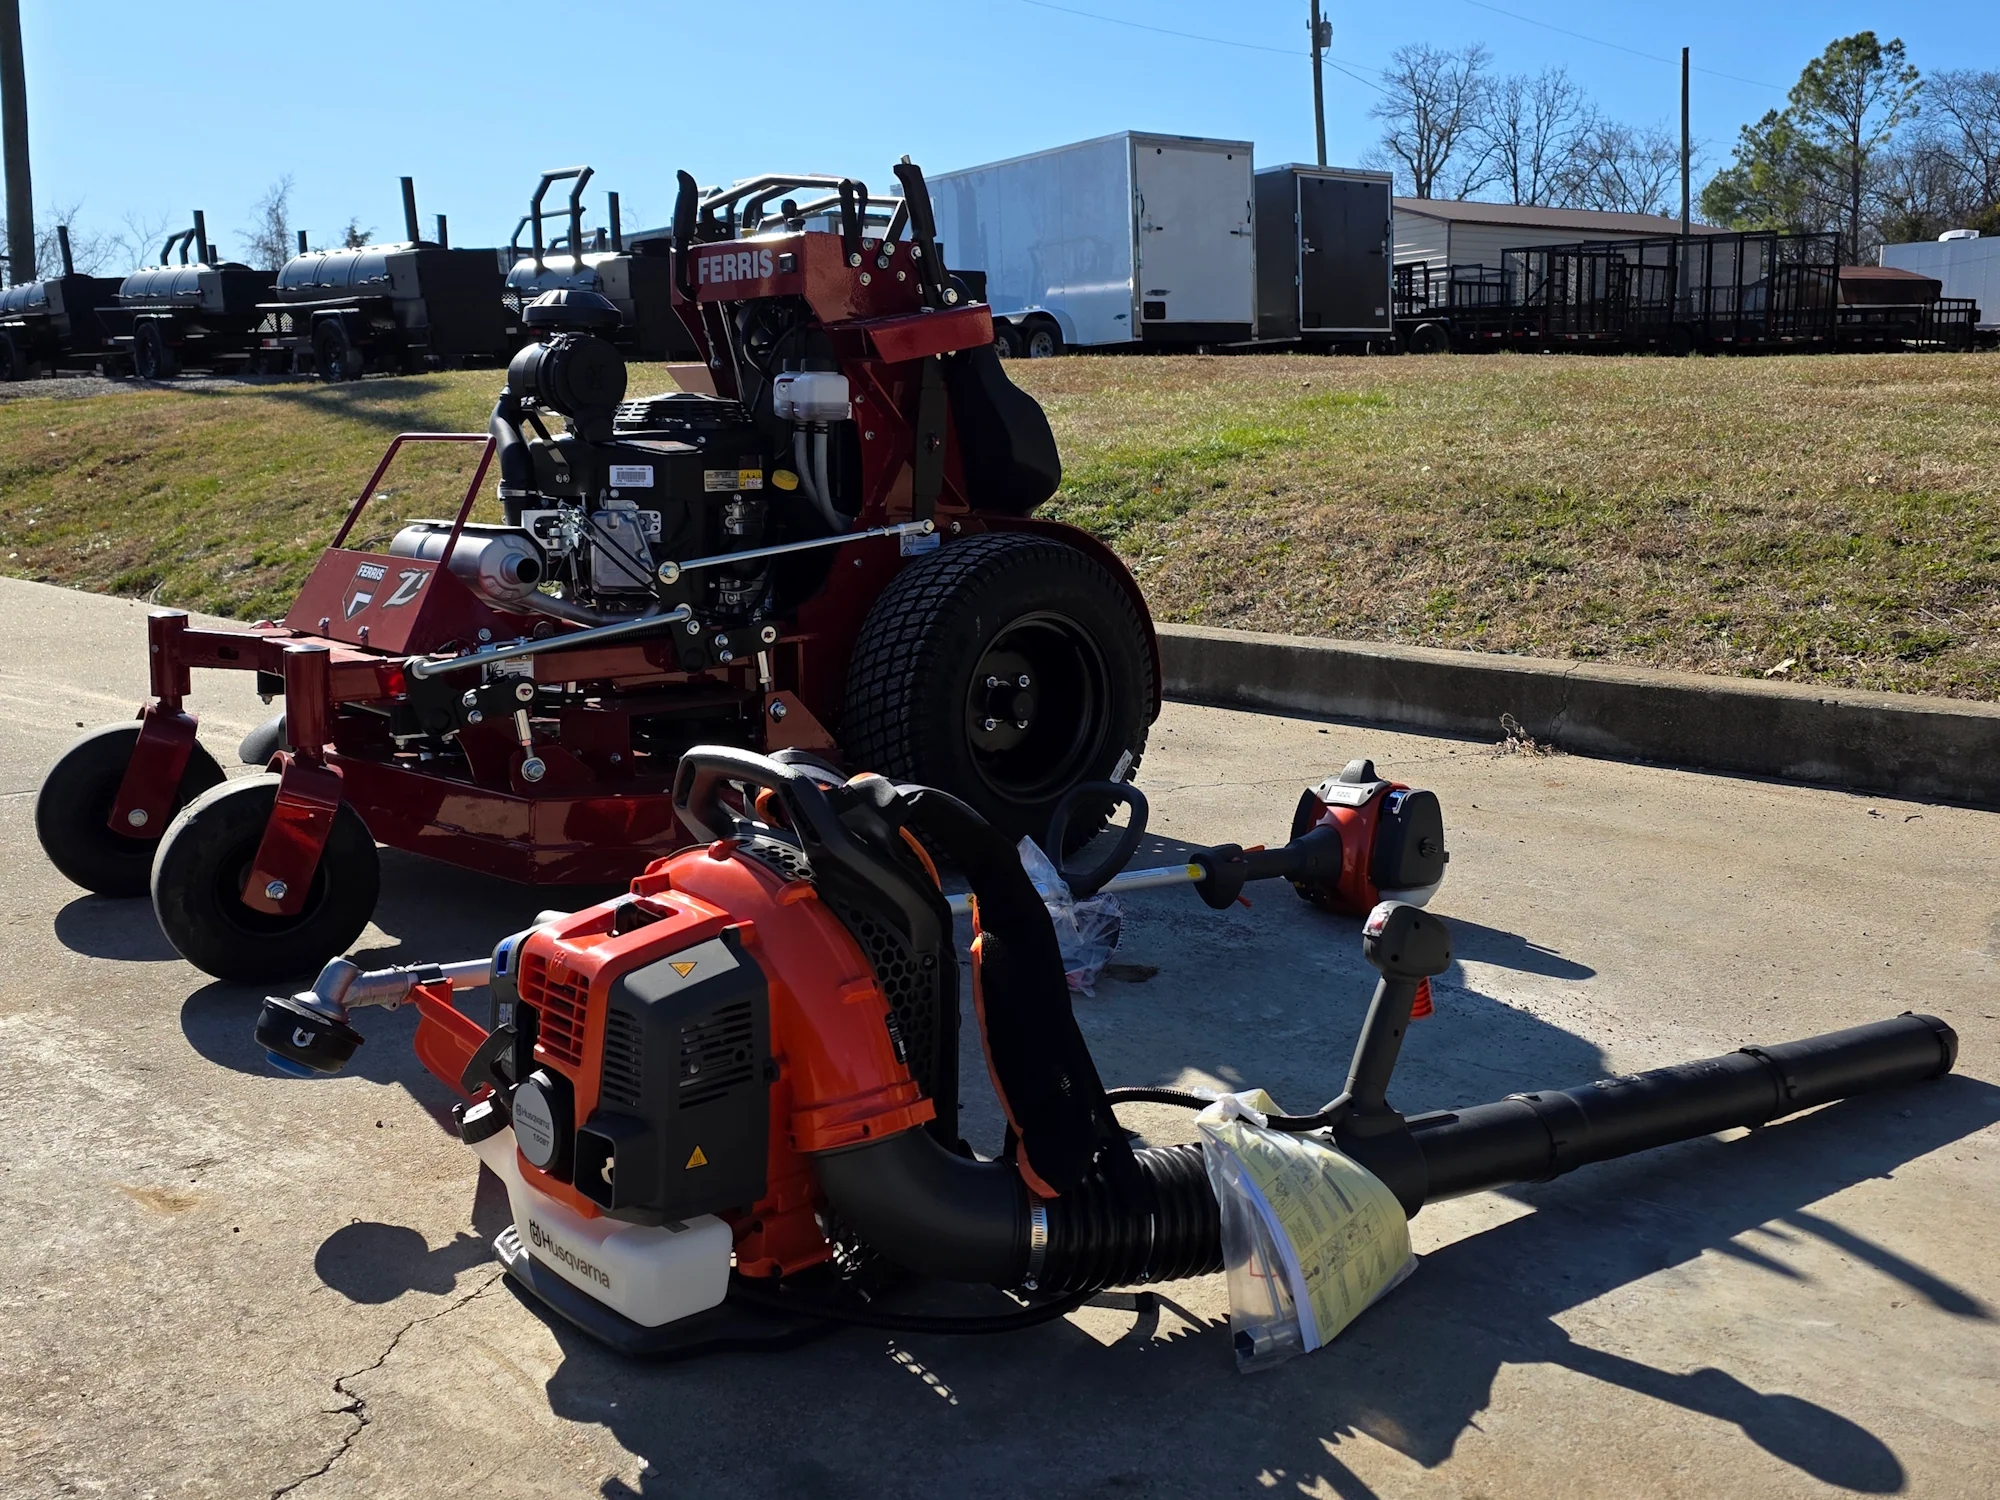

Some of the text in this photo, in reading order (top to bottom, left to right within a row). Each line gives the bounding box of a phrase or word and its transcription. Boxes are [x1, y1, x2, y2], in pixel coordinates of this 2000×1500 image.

[698, 249, 774, 284] FERRIS
[357, 565, 385, 580] FERRIS
[521, 1106, 550, 1130] Husqvarna
[541, 1230, 610, 1289] Husqvarna
